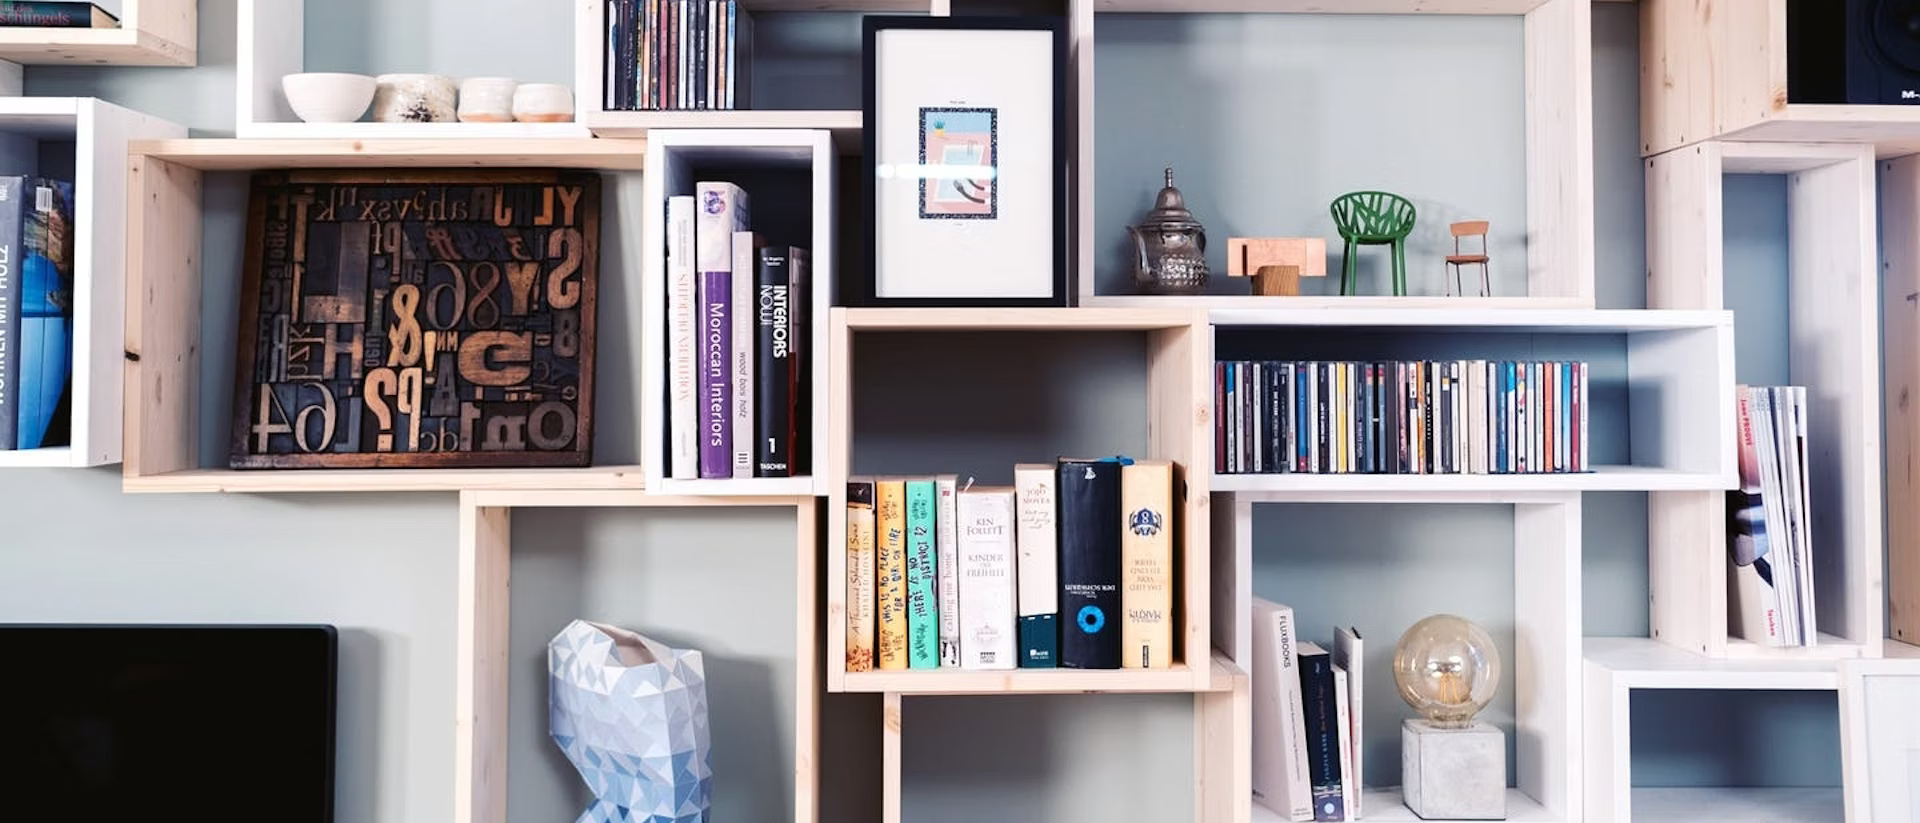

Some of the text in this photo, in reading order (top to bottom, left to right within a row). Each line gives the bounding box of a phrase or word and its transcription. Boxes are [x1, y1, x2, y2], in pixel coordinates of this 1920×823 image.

[773, 284, 788, 358] INTERIORS
[710, 303, 725, 447] Moroccan Interiors
[738, 351, 747, 376] wood
[738, 398, 747, 419] holz
[768, 437, 776, 454] 1
[760, 462, 787, 471] TASCHEN
[967, 525, 1004, 537] FOLLETT
[975, 517, 994, 526] KEN
[848, 522, 859, 546] Suns
[848, 547, 863, 586] Splendid
[880, 546, 889, 572] PLACE
[908, 556, 918, 570] NO
[917, 541, 932, 580] DISTRICT
[943, 552, 953, 579] home
[968, 553, 1004, 562] KINDER
[880, 575, 890, 588] NO
[882, 604, 894, 624] THIS
[914, 589, 928, 618] THERE
[943, 599, 955, 632] calling
[1128, 608, 1162, 620] MARTIN
[1279, 615, 1292, 669] FLUXBOOKS
